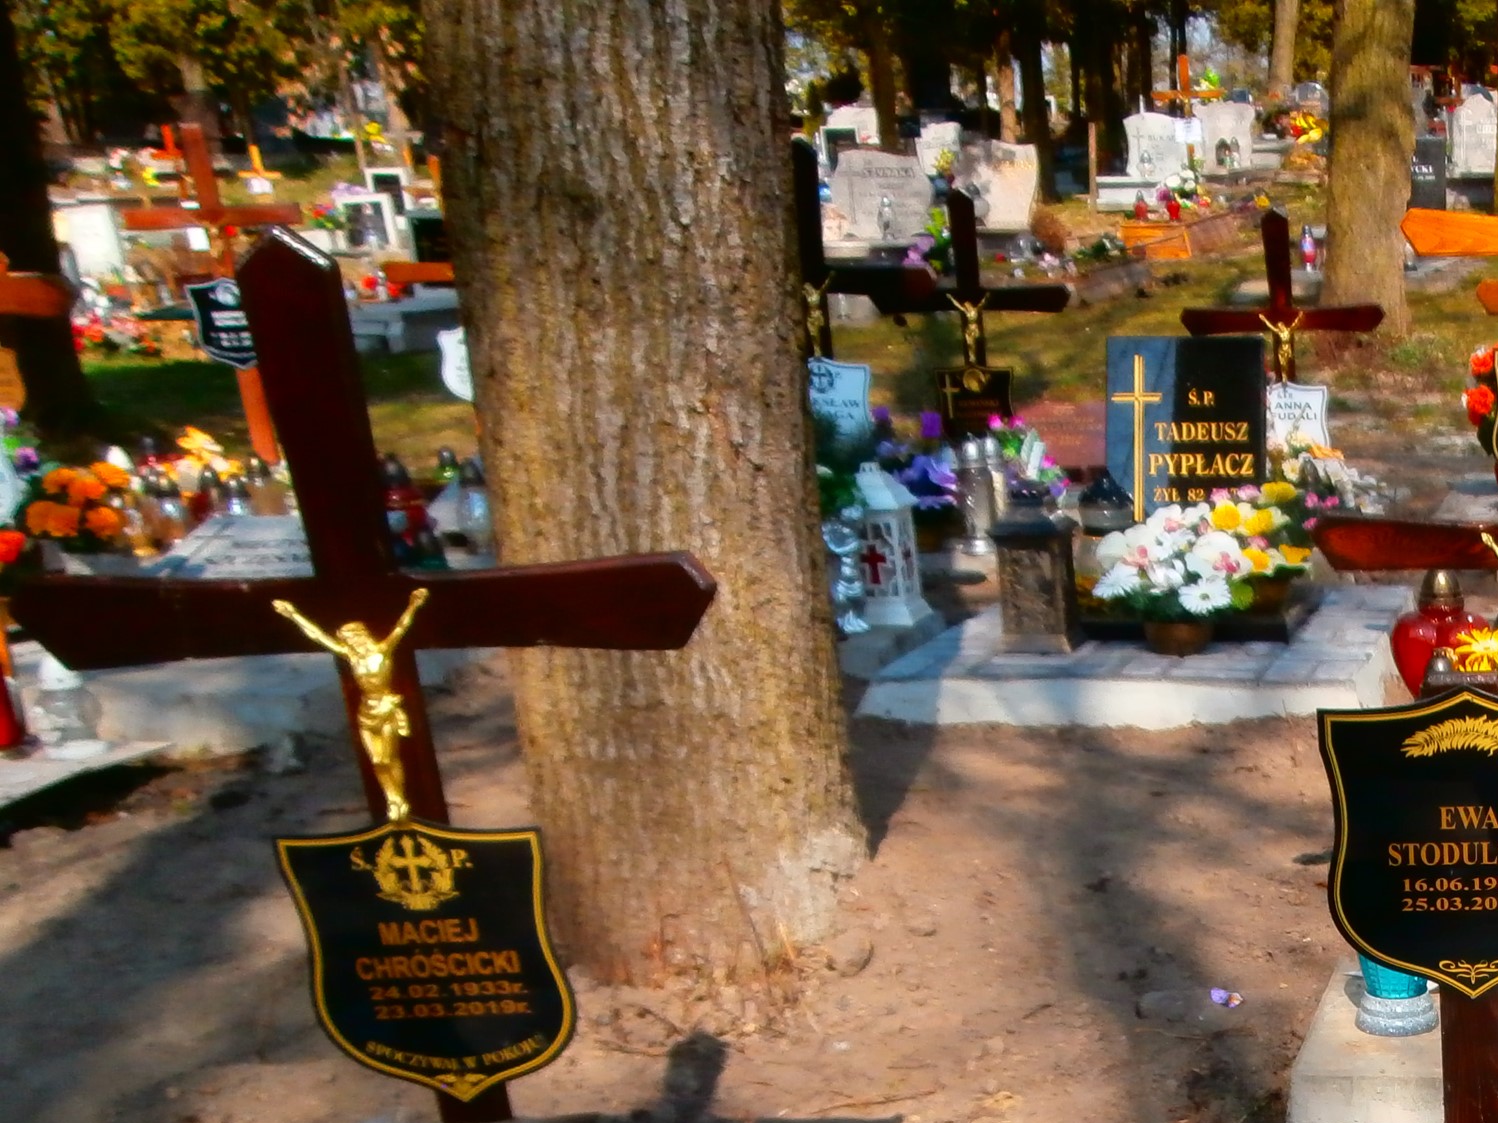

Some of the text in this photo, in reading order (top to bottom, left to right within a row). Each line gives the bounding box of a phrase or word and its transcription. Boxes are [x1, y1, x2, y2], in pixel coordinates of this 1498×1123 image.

[1203, 390, 1214, 406] P.
[1275, 402, 1312, 410] ANNA
[1154, 422, 1249, 442] TADEUSZ
[1149, 453, 1254, 476] PYPŁACZ
[1154, 484, 1180, 501] ŻYŁ
[1188, 488, 1204, 501] 82
[350, 846, 474, 871] Ś. P.
[378, 918, 480, 946] MACIEJ
[356, 948, 522, 981] CHRÓŚCICKI
[370, 981, 530, 1001] 24.02.1933r.
[374, 1001, 533, 1021] 23.03.2019r.
[365, 1034, 545, 1071] SPOCZYWAJ W POKOJU
